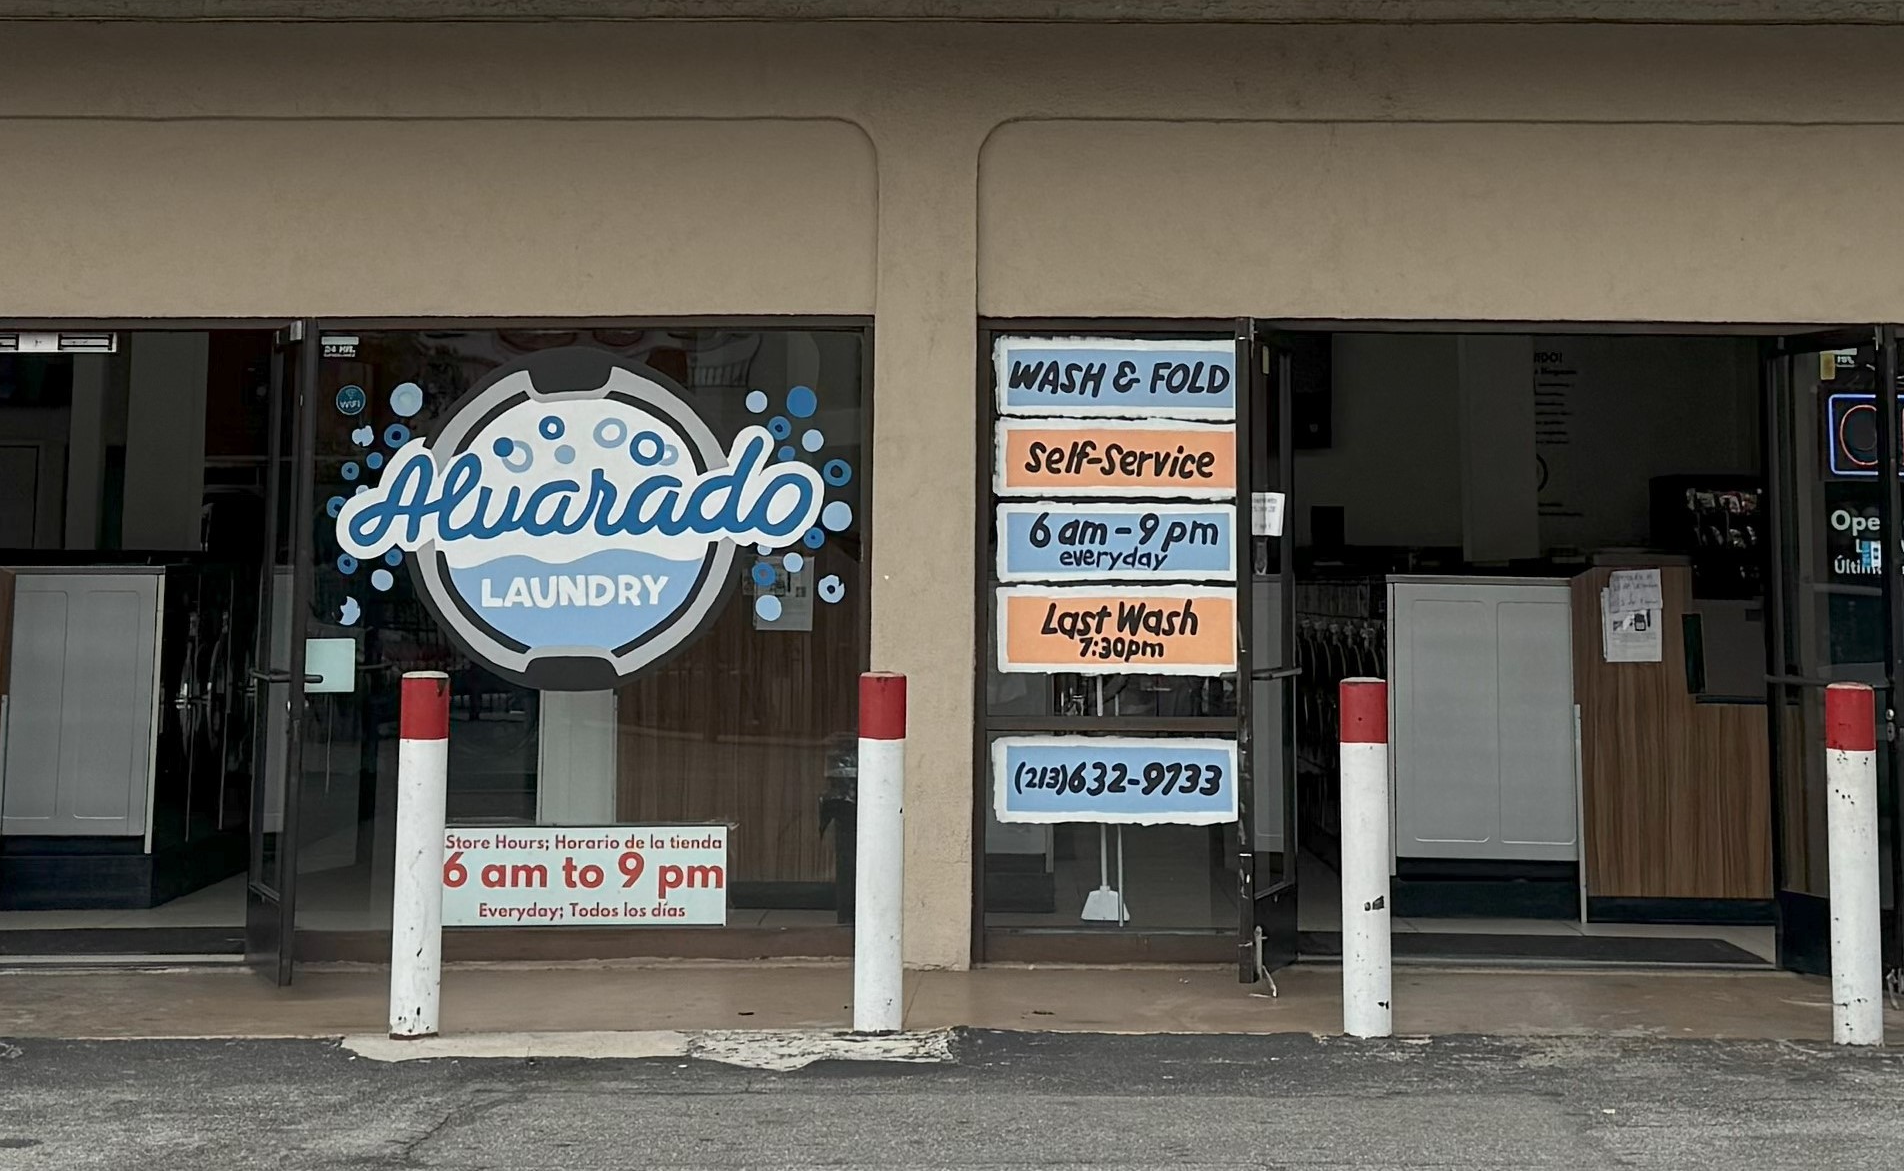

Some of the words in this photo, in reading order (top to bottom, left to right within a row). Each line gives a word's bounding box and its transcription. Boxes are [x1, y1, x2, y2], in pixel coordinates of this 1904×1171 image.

[1008, 360, 1106, 398] WASH
[1113, 361, 1141, 393] &
[1149, 361, 1230, 394] FOLD
[1024, 440, 1215, 479] Self-Service
[349, 435, 813, 547] Alvarado
[1029, 512, 1052, 548] 6
[1057, 519, 1108, 546] am
[1138, 513, 1160, 545] 9
[1161, 520, 1219, 552] pm
[1831, 509, 1881, 537] Ope
[1059, 547, 1168, 570] everyday
[481, 575, 668, 608] LAUNDRY
[1041, 602, 1112, 640] Last
[1117, 598, 1199, 636] Wash
[1079, 637, 1164, 662] 7:30pm
[445, 835, 490, 850] Store
[495, 835, 550, 851] Hours;
[555, 835, 620, 849] Horario
[625, 835, 645, 849] de
[650, 835, 664, 849] la
[670, 835, 722, 849] tienda
[443, 851, 468, 888] 6
[481, 864, 548, 888] am
[562, 857, 604, 888] to
[618, 851, 645, 888] 9
[658, 864, 723, 899] pm
[479, 903, 564, 921] Everyday;
[570, 903, 619, 917] Todos
[624, 902, 646, 917] los
[651, 902, 686, 917] días
